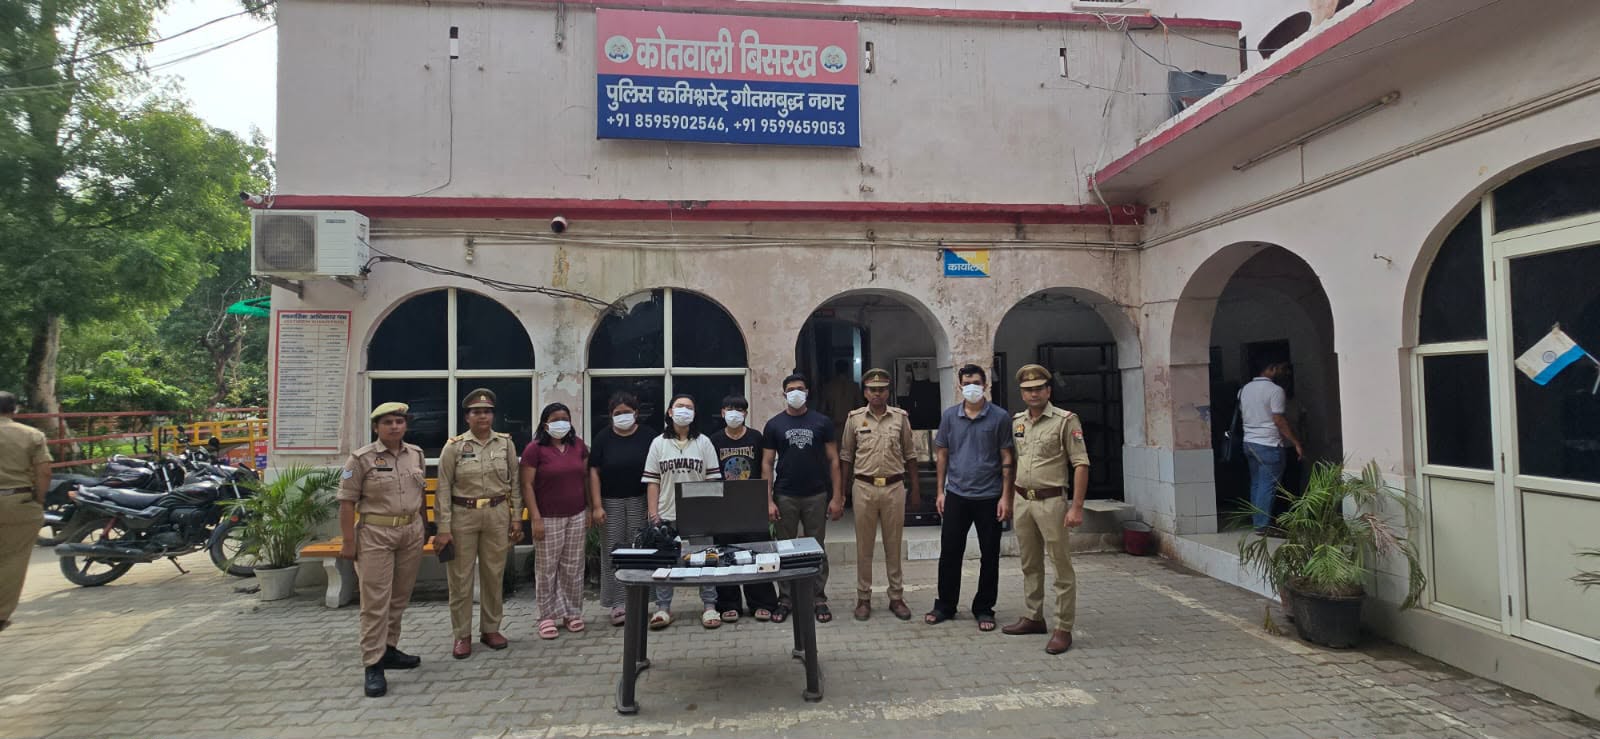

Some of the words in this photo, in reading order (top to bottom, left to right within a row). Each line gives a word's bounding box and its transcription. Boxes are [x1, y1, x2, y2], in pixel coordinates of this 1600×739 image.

[635, 26, 734, 74] कोतवाली
[739, 30, 818, 78] बिसरख
[605, 78, 654, 111] पुलिस
[731, 84, 805, 117] गौतमबुद्ध
[808, 93, 847, 111] नगर
[607, 113, 630, 128] +91
[635, 113, 729, 133] 8595902546,
[733, 119, 756, 133] +91
[761, 119, 845, 136] 9599659053
[659, 457, 704, 474] HOGWARTS
